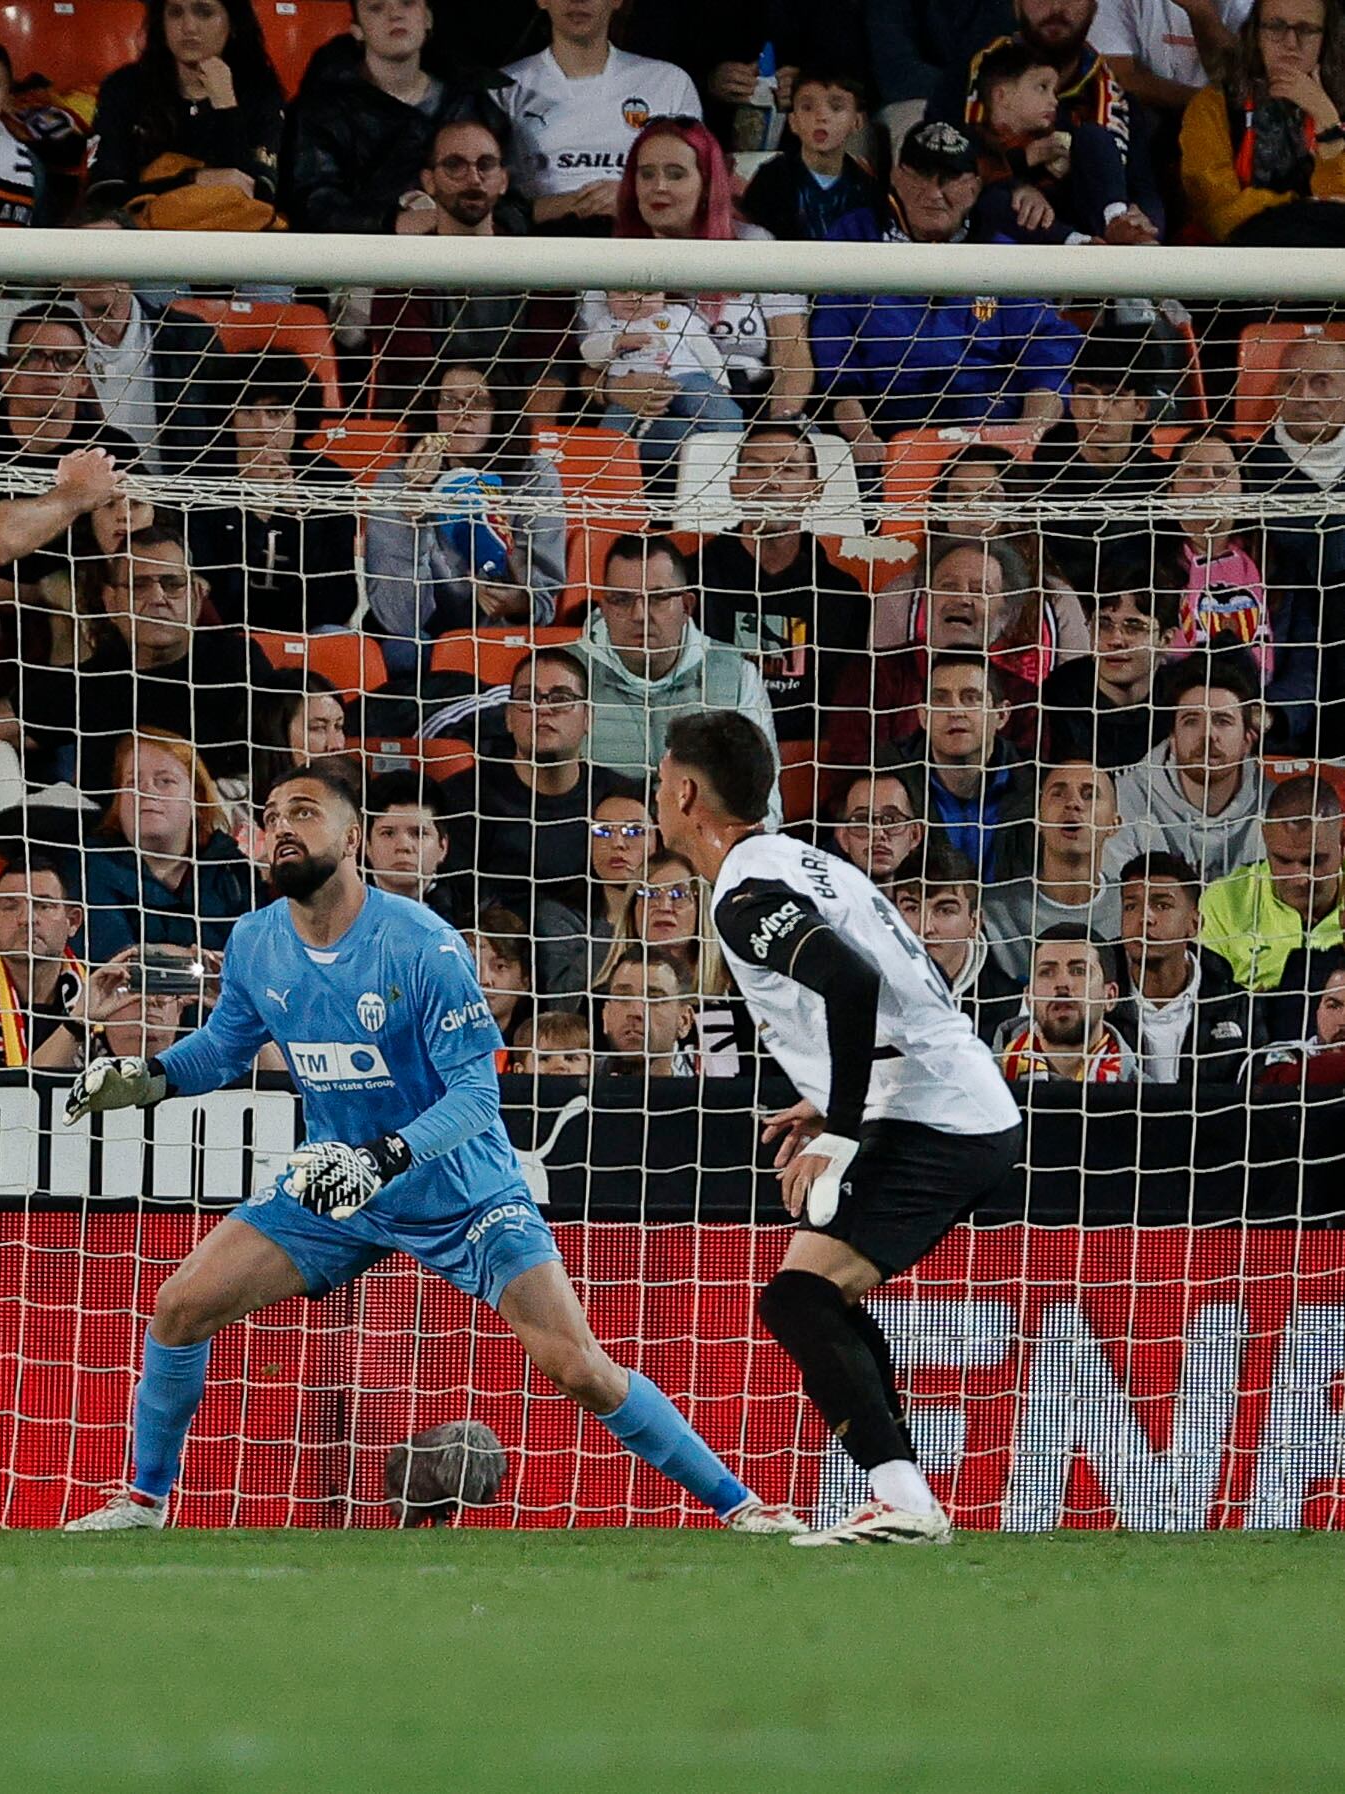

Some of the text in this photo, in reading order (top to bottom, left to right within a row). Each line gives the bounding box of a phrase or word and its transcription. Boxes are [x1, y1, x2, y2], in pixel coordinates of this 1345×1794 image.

[750, 901, 801, 960] divina
[296, 1053, 328, 1073] TM
[365, 1079, 396, 1090] Group
